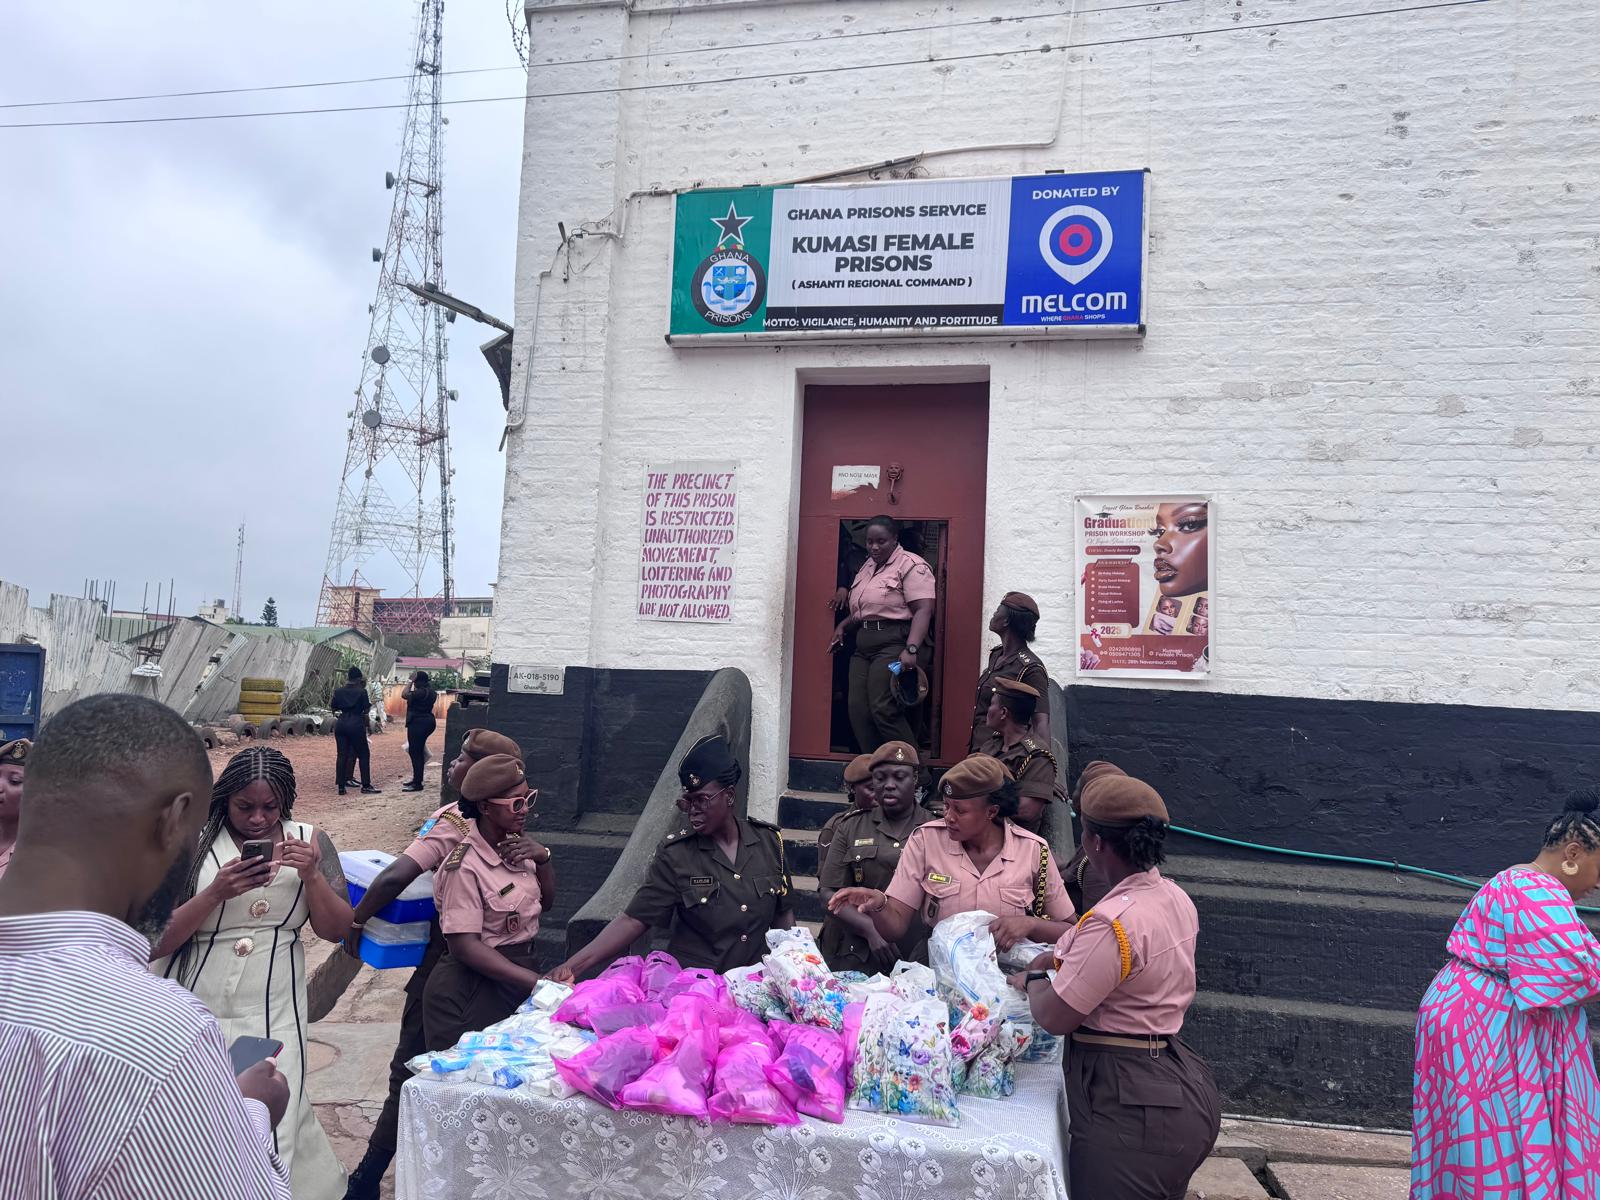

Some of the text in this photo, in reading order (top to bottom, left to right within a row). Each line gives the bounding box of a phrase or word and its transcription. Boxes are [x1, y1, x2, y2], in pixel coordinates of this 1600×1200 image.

[1032, 186, 1120, 200] DONATED BY
[788, 203, 986, 221] GHANA PRISONS SERVICE
[792, 232, 975, 254] KUMASI FEMALE
[710, 252, 749, 262] GHANA
[835, 255, 932, 273] PRISONS
[848, 279, 902, 288] REGIONAL
[1022, 292, 1127, 313] MELCOM
[705, 311, 752, 323] PRISONS
[762, 316, 998, 328] MOTTO: VIGILANCE, HUMANITY AND FORTITUDE
[648, 473, 734, 489] THE PRECINCT
[646, 493, 736, 508] OF THIS PRISON
[646, 511, 734, 526] IS RESTRICTED.
[644, 529, 734, 544] UNAUTHORIZED
[642, 547, 720, 565] MOVEMENT,
[642, 566, 732, 582] LOITERING AND
[641, 584, 731, 600] PHOTOGRAPHY
[639, 602, 656, 615] ARE
[658, 604, 680, 618] NOT
[1100, 626, 1121, 634] 2025
[514, 673, 559, 681] AK-018-5190
